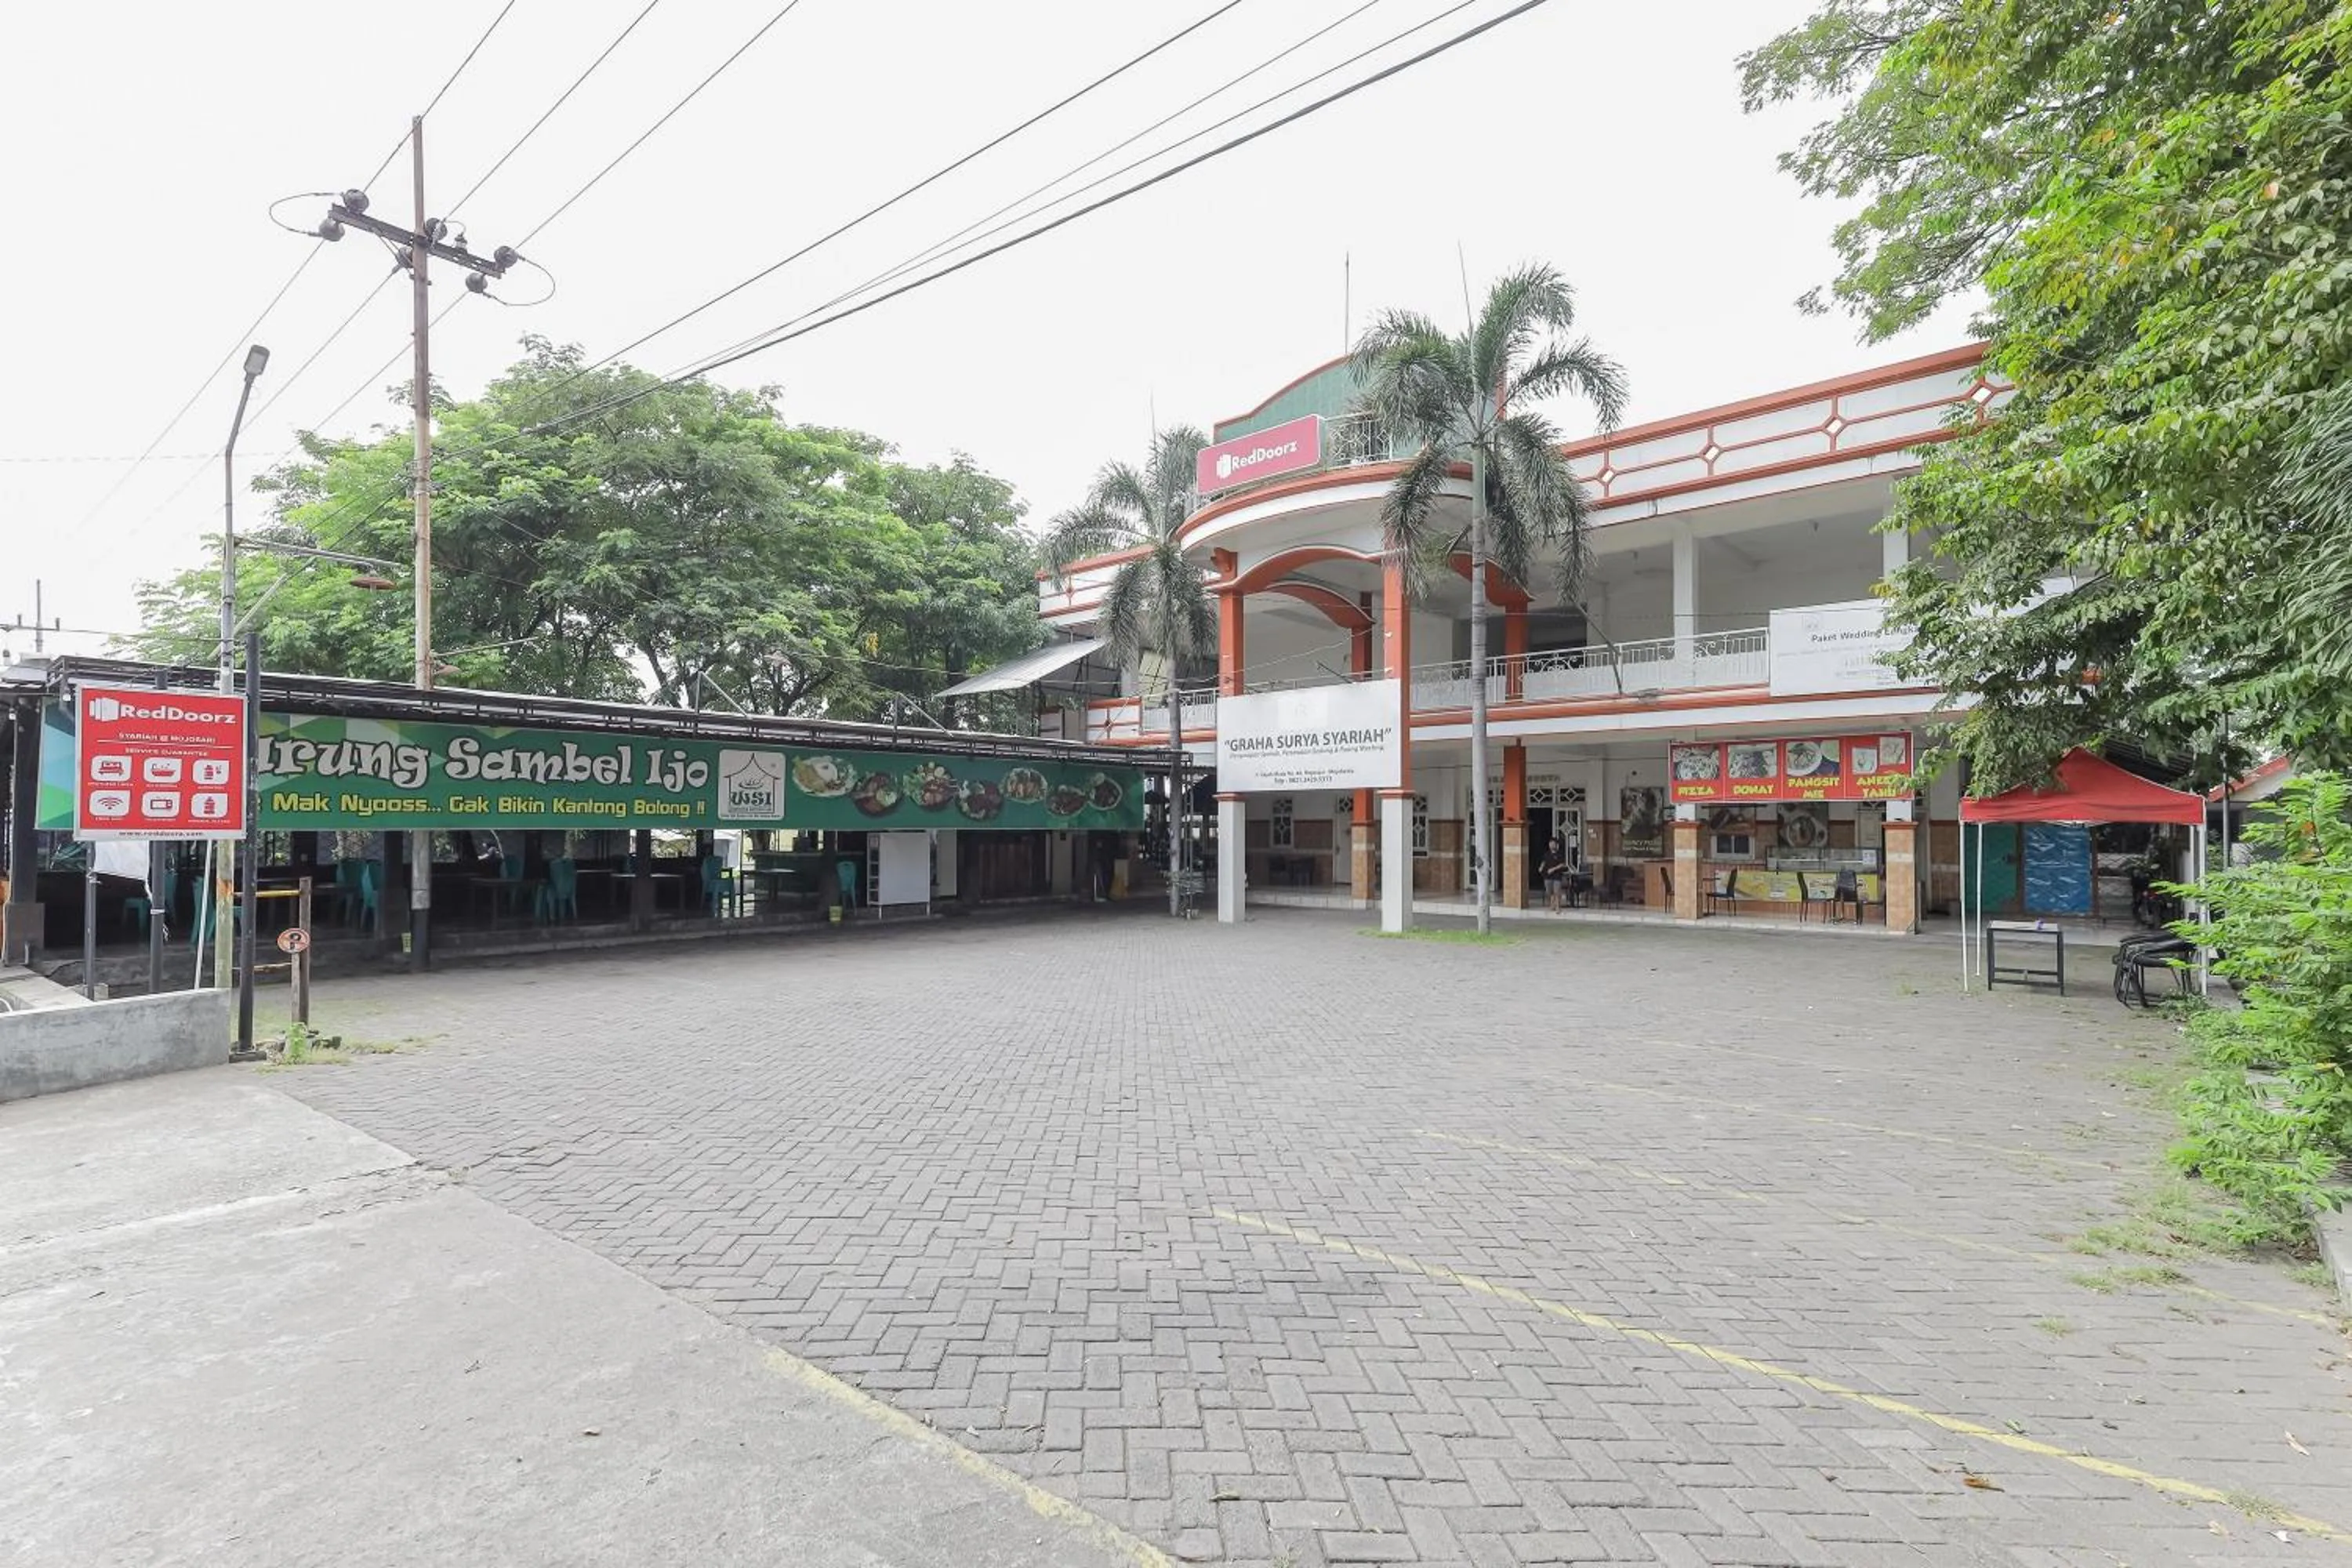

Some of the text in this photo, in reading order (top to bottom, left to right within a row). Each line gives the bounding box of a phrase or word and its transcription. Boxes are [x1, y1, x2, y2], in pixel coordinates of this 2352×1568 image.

[1232, 441, 1298, 471] RedDoorz
[1812, 633, 1837, 642] Paket
[1840, 630, 1882, 640] Wedding
[120, 704, 237, 724] RedDoorz
[1277, 733, 1319, 749] SURYA
[445, 737, 632, 784] Sambel
[645, 749, 709, 793] Ijo
[272, 792, 331, 812] Mak
[448, 795, 491, 814] Gak
[497, 797, 546, 814] Bikin
[633, 799, 691, 818] Bolong
